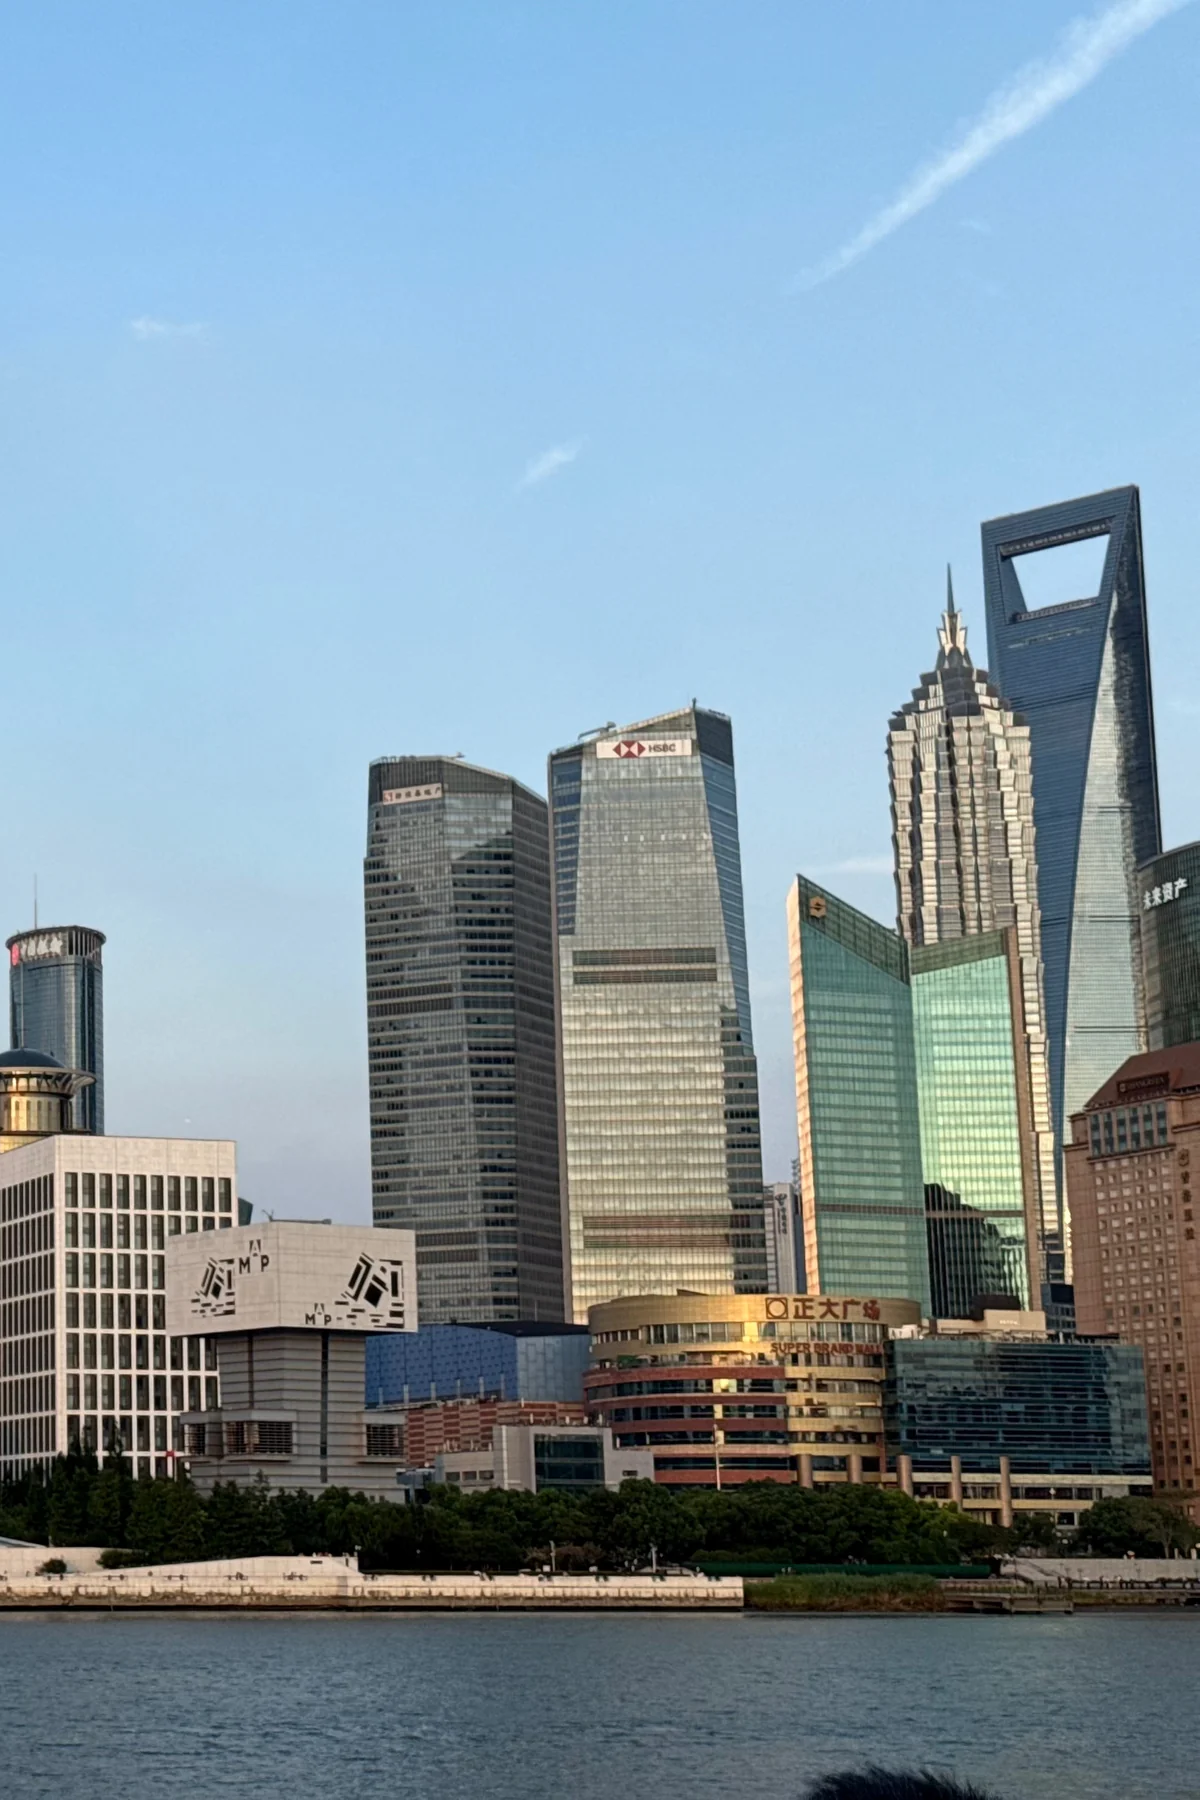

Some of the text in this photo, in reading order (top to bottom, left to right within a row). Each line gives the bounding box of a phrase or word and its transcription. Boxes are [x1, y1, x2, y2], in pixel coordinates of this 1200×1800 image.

[648, 743, 676, 753] HSBC
[1143, 877, 1188, 910] 未来资产
[239, 1239, 270, 1274] MAP
[305, 1303, 332, 1326] MAP
[793, 1298, 881, 1320] 正大广场
[771, 1342, 810, 1354] SUPER
[814, 1343, 854, 1355] BRAND
